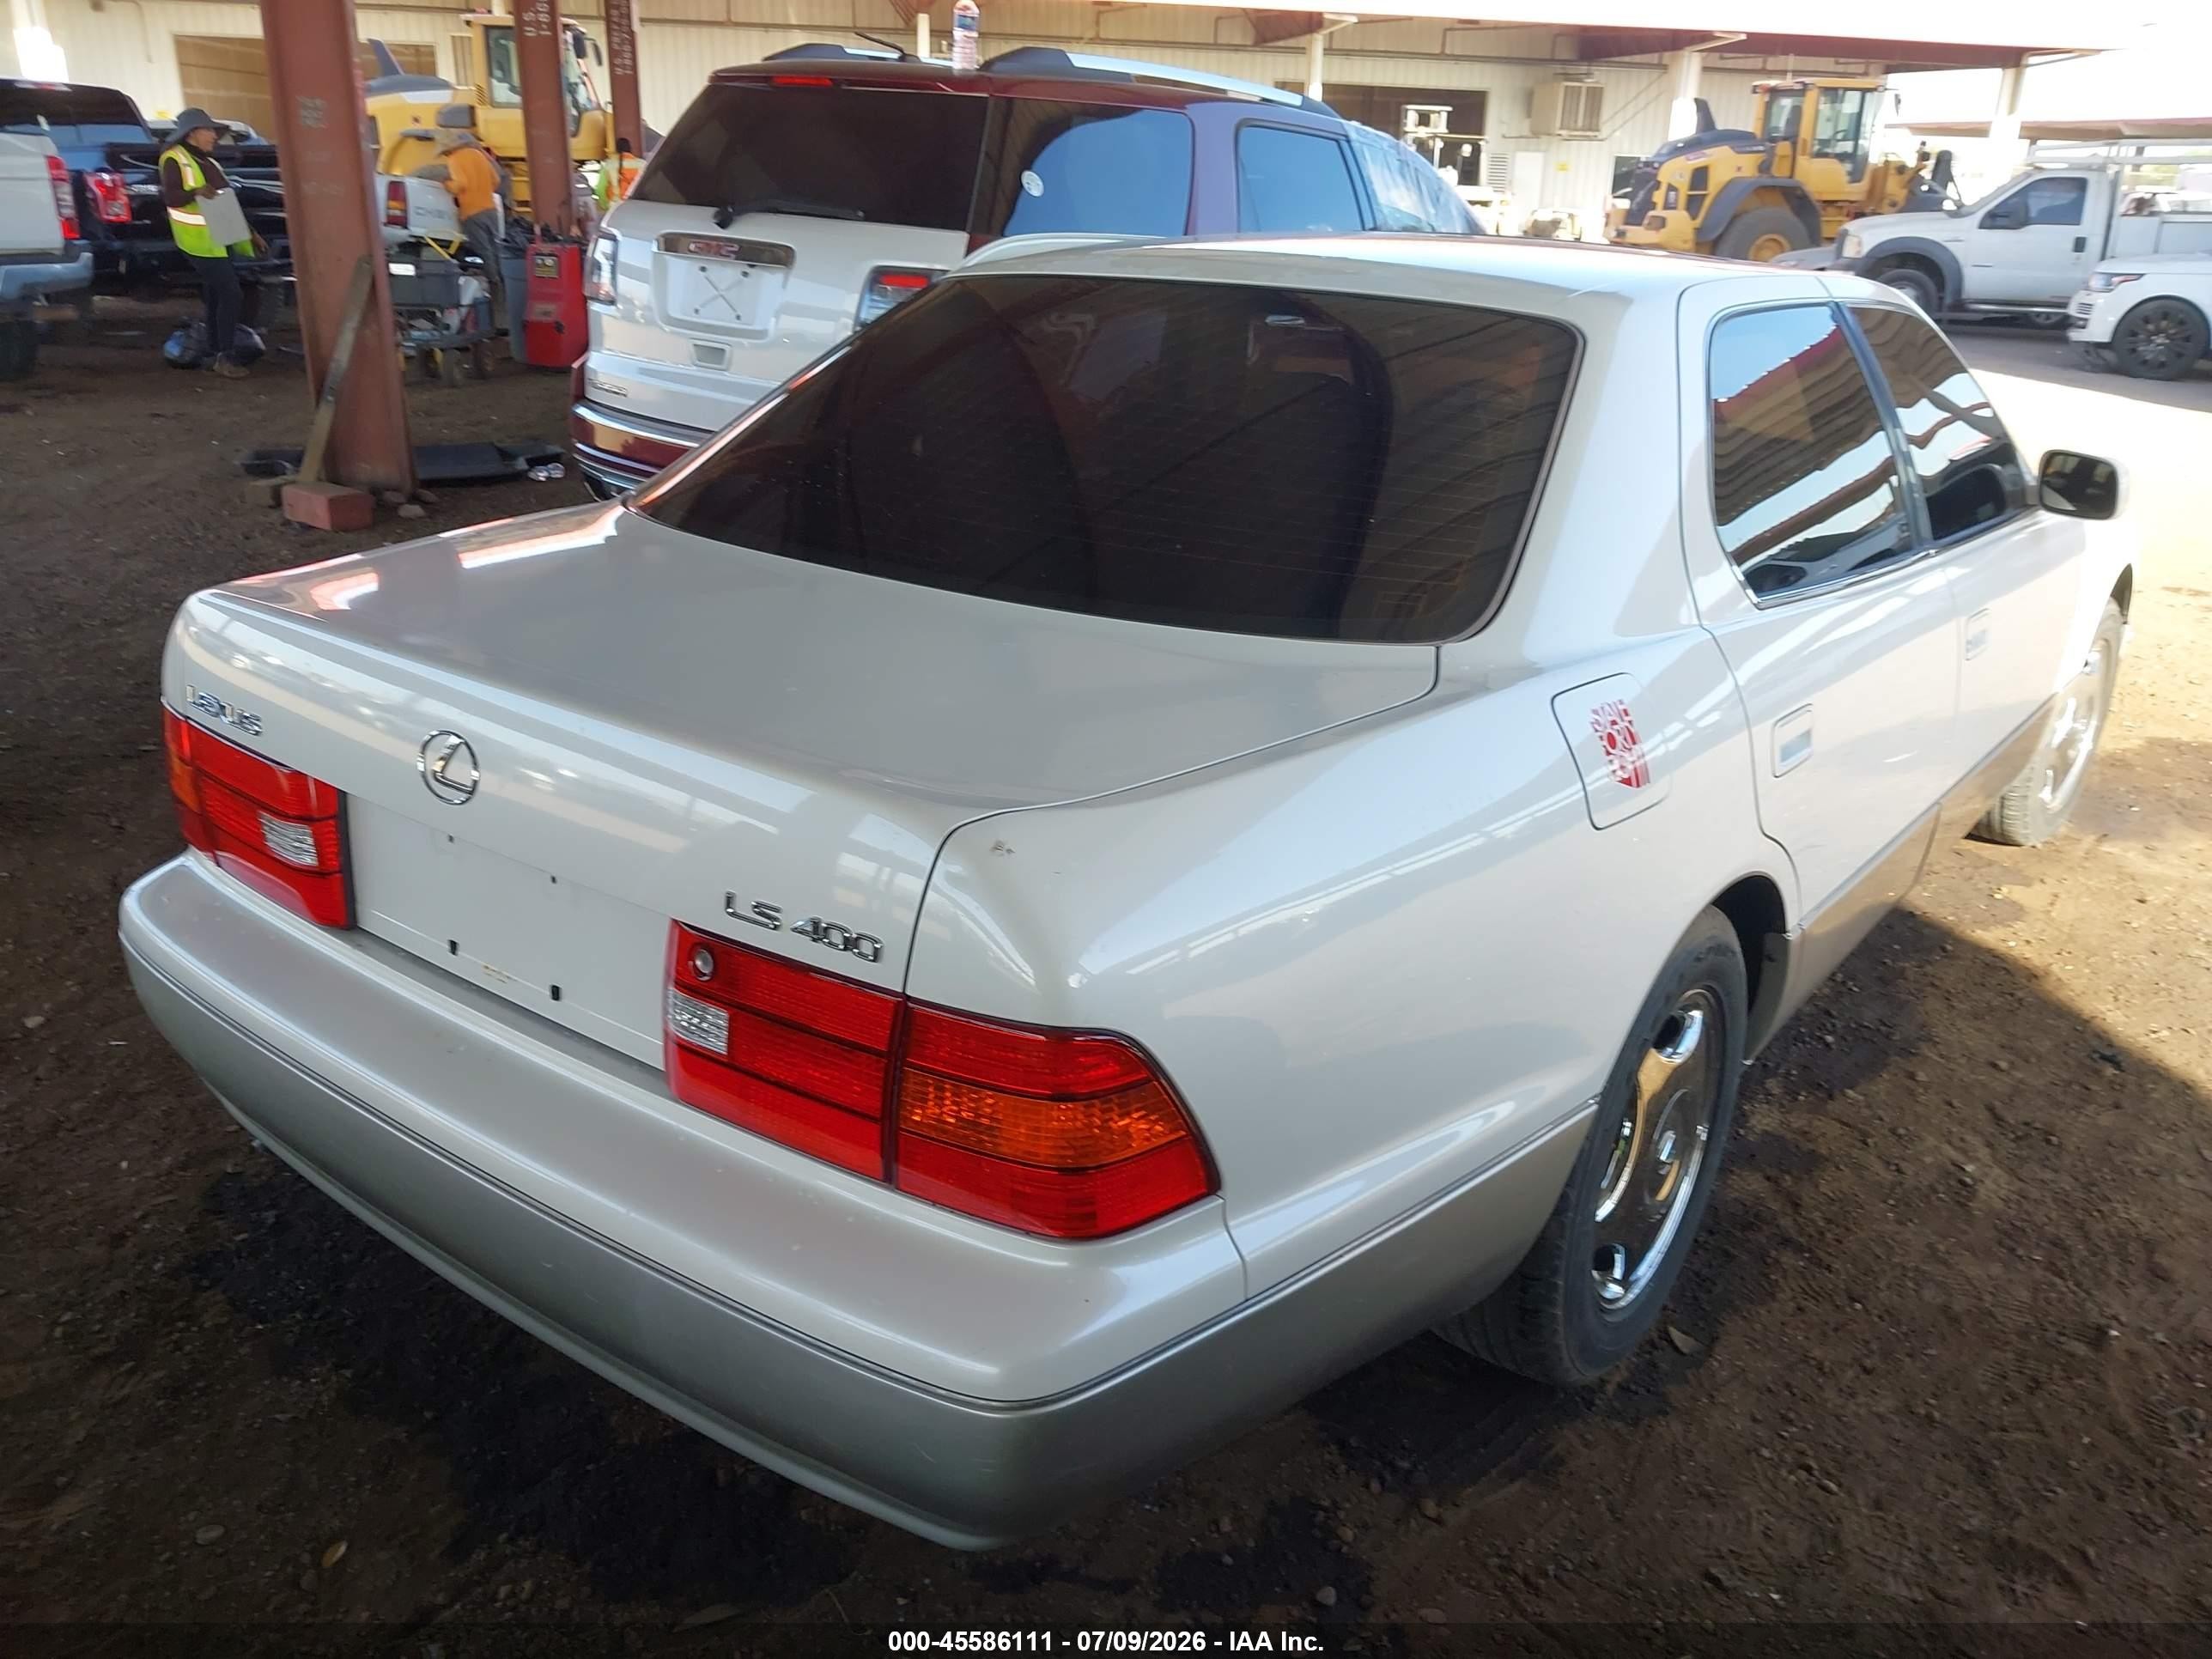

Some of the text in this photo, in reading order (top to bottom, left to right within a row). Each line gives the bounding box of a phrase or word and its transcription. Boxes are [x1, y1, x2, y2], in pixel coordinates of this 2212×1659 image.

[185, 684, 263, 737] LEXUS
[725, 890, 884, 963] LS 400
